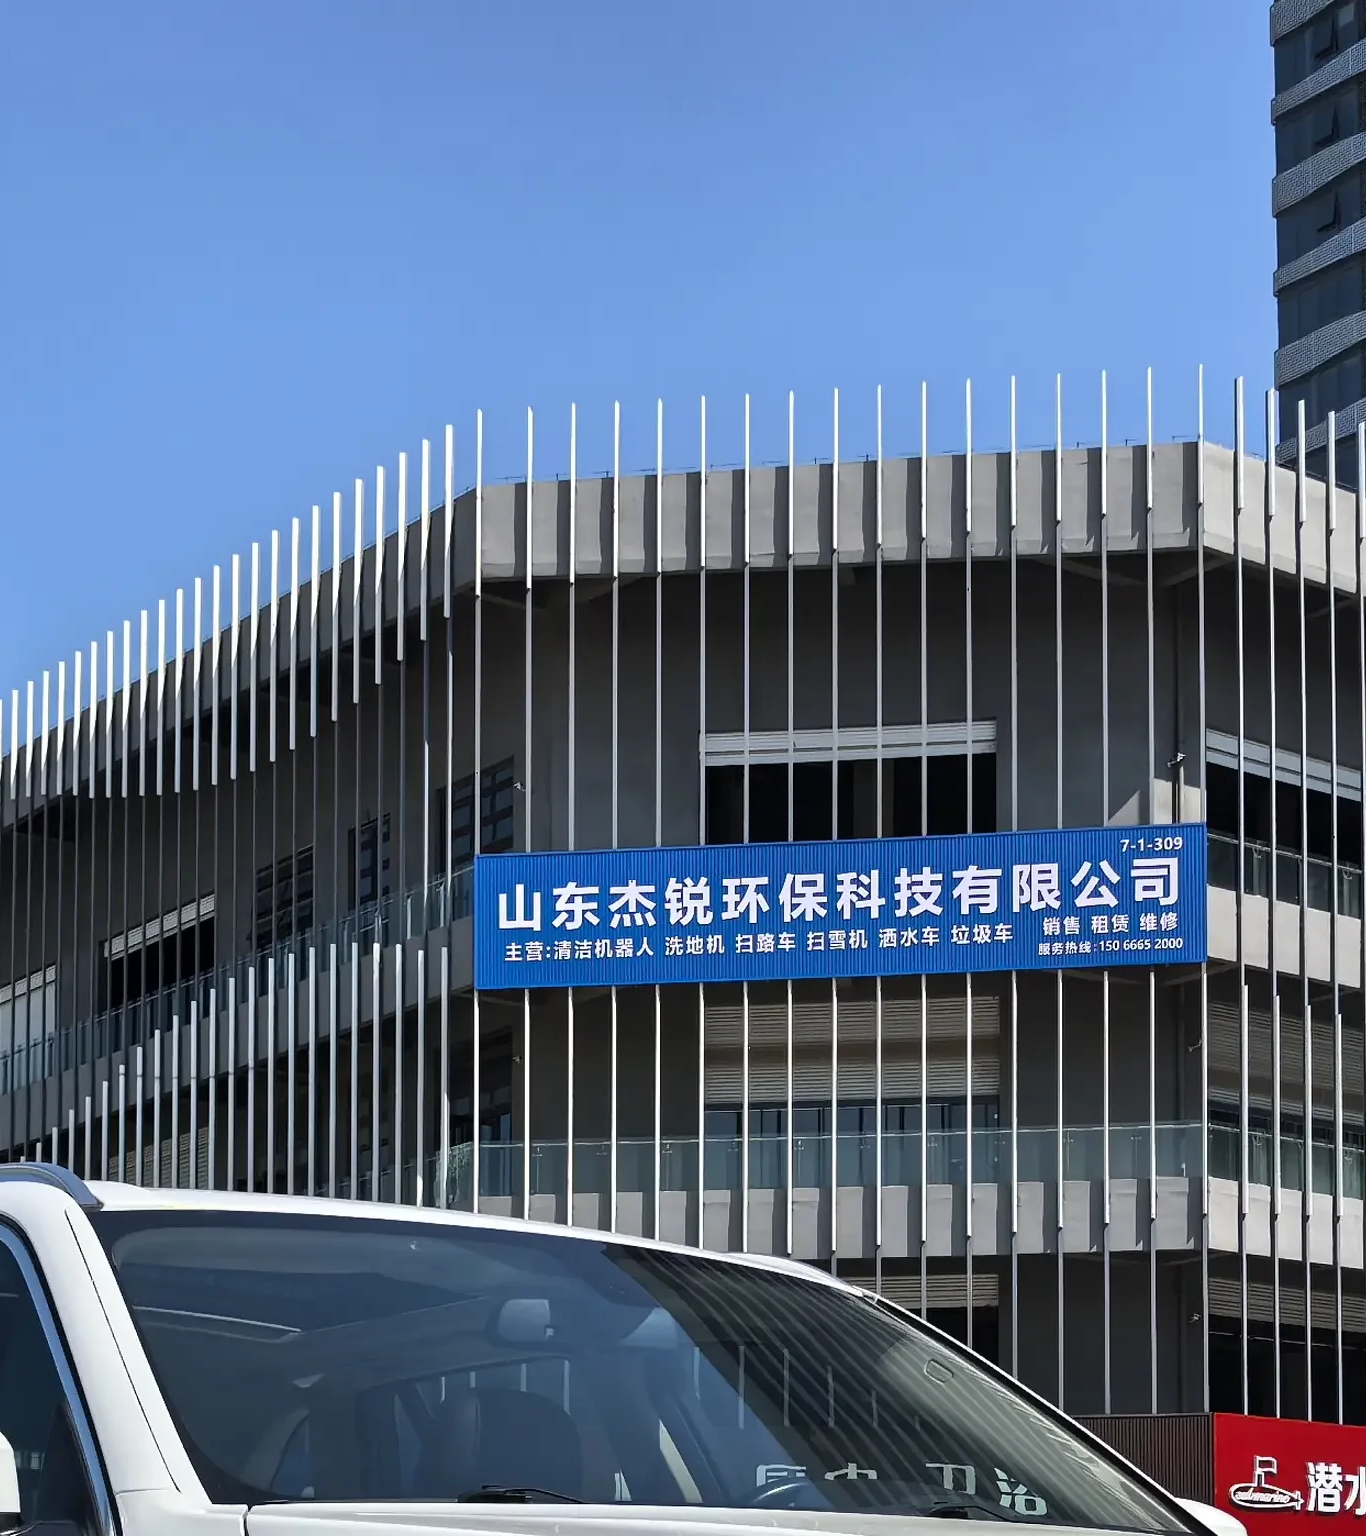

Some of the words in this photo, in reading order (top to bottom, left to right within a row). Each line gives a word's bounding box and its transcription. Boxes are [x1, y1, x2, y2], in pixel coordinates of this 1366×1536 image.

[1120, 837, 1183, 852] 7-1-309
[499, 857, 1179, 931] 山东杰锐环保科技有限公司
[1043, 916, 1080, 936] 销售
[1091, 914, 1129, 934] 租赁
[1139, 912, 1178, 931] 维修
[665, 934, 725, 957] 洗地机
[735, 932, 796, 954] 扫路车
[807, 929, 867, 951] 扫雪机
[878, 926, 940, 948] 洒水车
[951, 923, 1014, 944] 垃圾车
[1123, 939, 1151, 951] 6665
[1154, 938, 1183, 950] 2000
